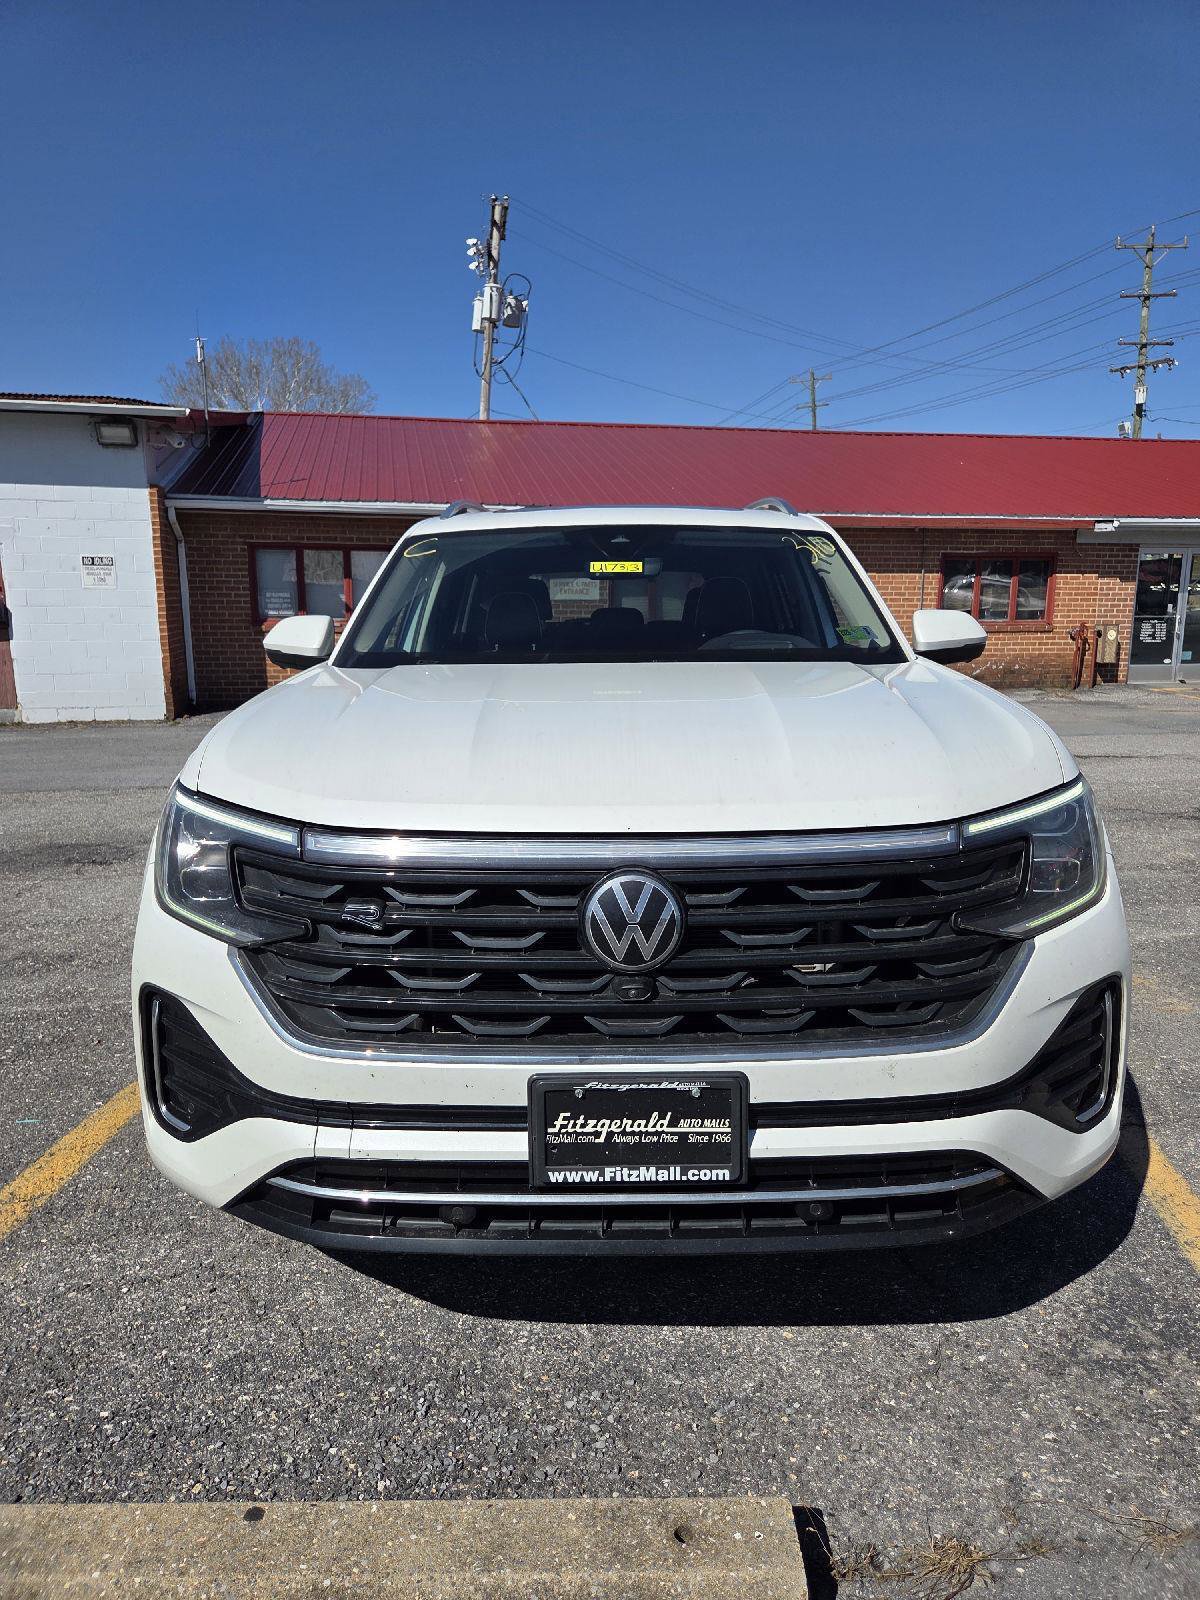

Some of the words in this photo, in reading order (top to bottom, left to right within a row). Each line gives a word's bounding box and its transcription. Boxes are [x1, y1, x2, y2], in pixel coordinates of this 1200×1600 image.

[83, 557, 92, 565] NO
[94, 557, 113, 565] IDLING
[574, 1081, 680, 1092] Fitzgerald
[547, 1112, 672, 1143] Fitzgerald
[678, 1119, 702, 1128] AUTO
[703, 1119, 730, 1128] MALLS
[546, 1133, 596, 1144] FitzMall.com
[612, 1133, 640, 1145] Always
[642, 1133, 659, 1143] Low
[660, 1133, 679, 1143] Price
[687, 1133, 710, 1143] Since
[712, 1133, 732, 1143] 1966
[548, 1166, 730, 1183] www.FitzMall.com
